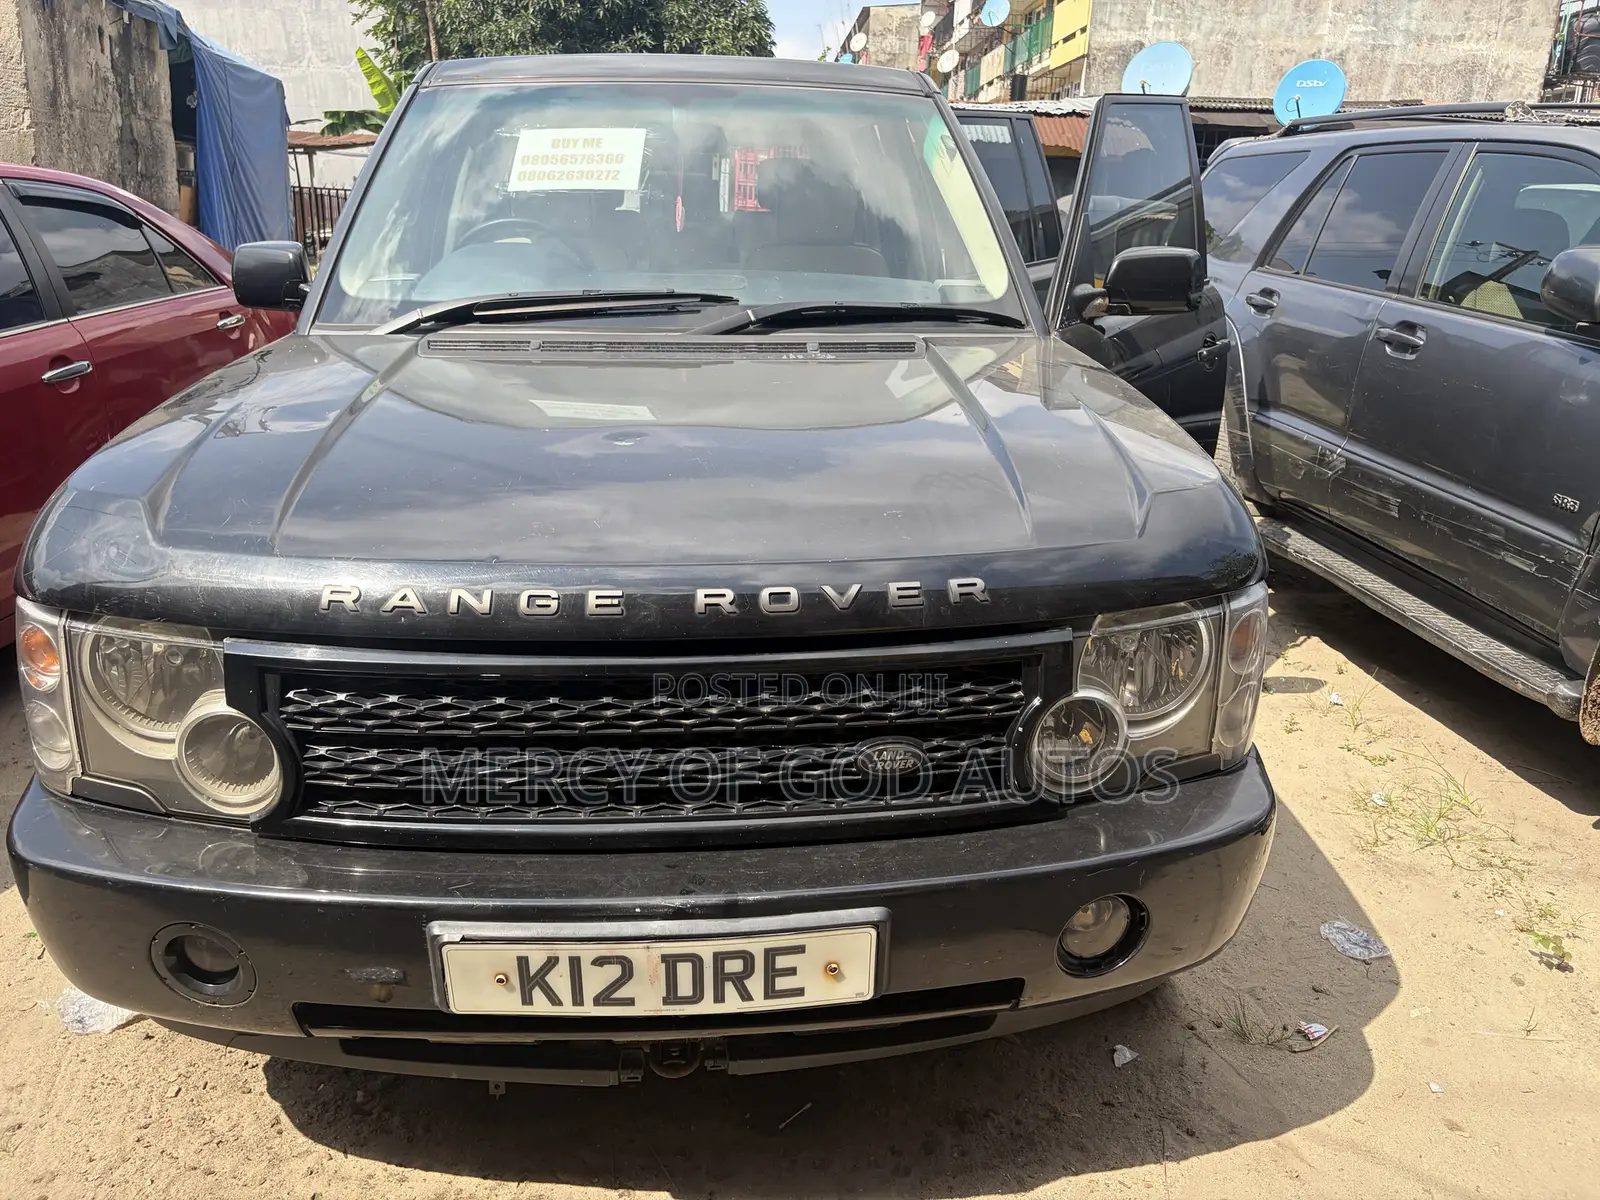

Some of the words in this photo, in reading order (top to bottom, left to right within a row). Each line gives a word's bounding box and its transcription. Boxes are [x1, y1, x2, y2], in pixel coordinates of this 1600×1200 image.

[551, 138, 580, 149] BUY
[582, 138, 604, 149] ME
[320, 584, 624, 616] RANGE
[696, 577, 990, 615] ROVER
[516, 955, 636, 1007] K12
[660, 944, 806, 1006] DRE
